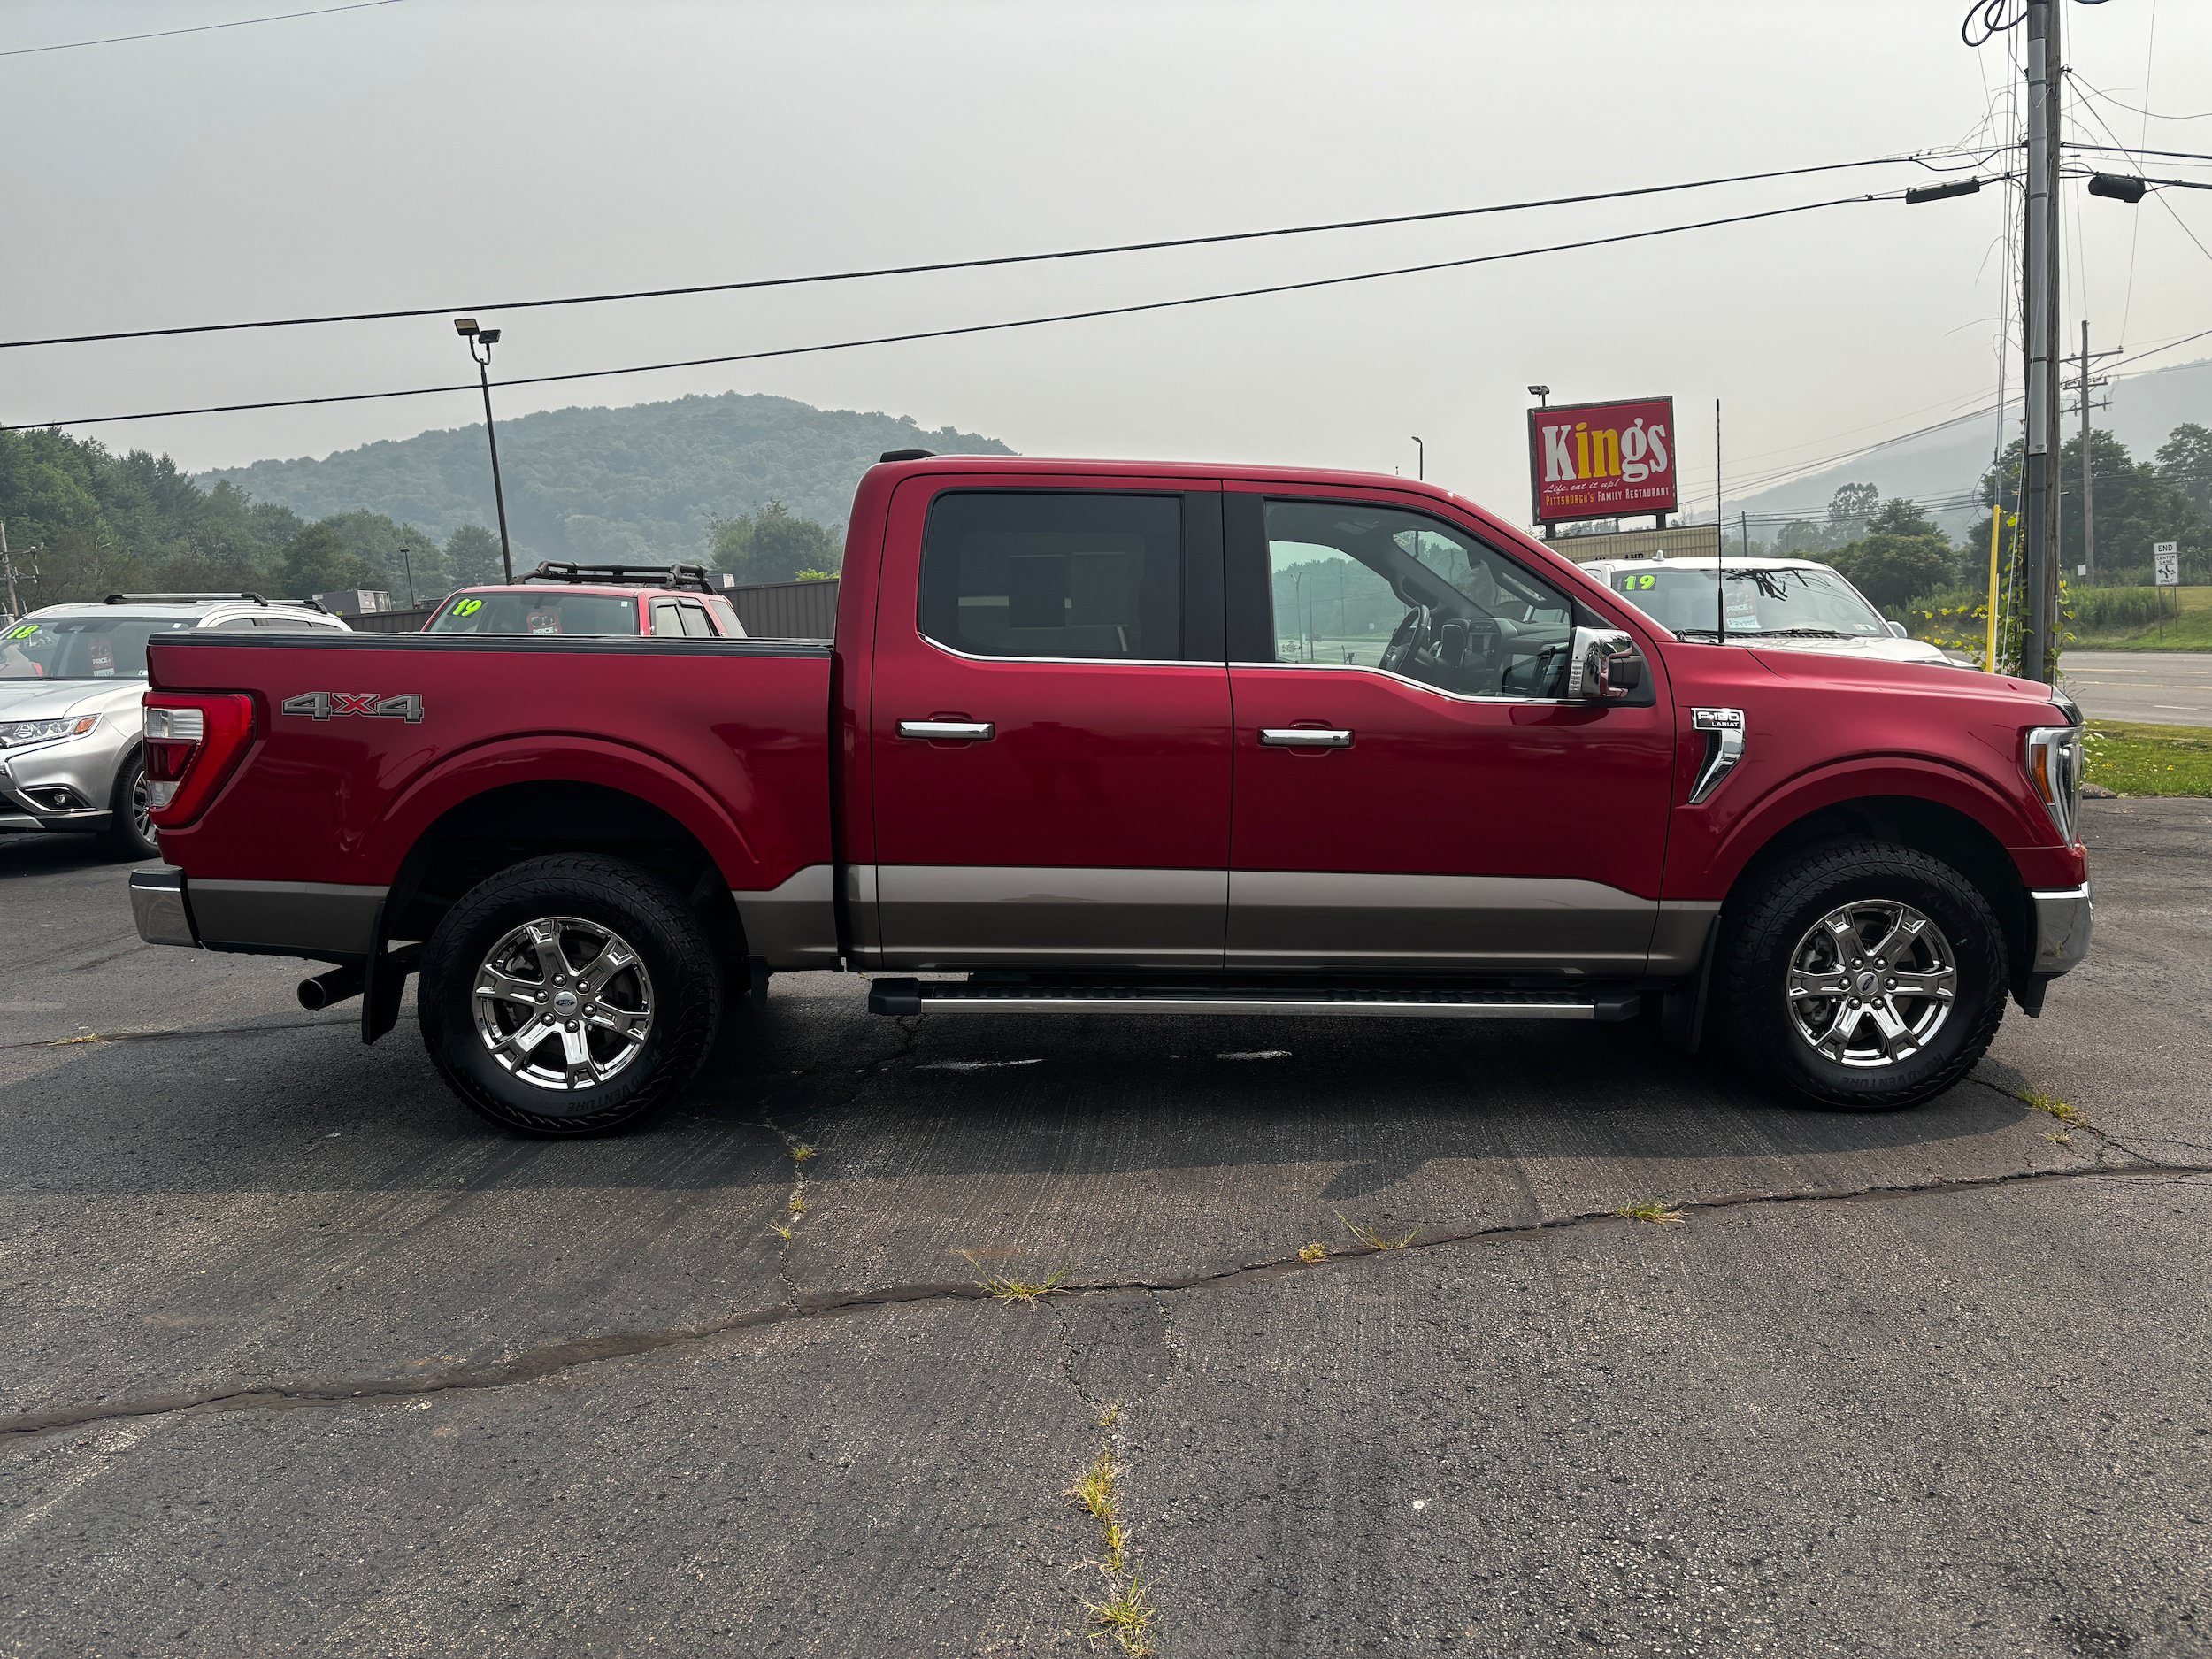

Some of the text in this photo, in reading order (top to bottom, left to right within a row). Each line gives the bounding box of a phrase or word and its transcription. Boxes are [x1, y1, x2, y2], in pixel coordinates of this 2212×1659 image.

[1601, 479, 1620, 489] up!
[1546, 487, 1670, 506] PITTSBURGH'S FAMILY RESTAURANT
[1624, 574, 1656, 590] 19
[452, 598, 482, 617] 19
[6, 625, 40, 639] 18
